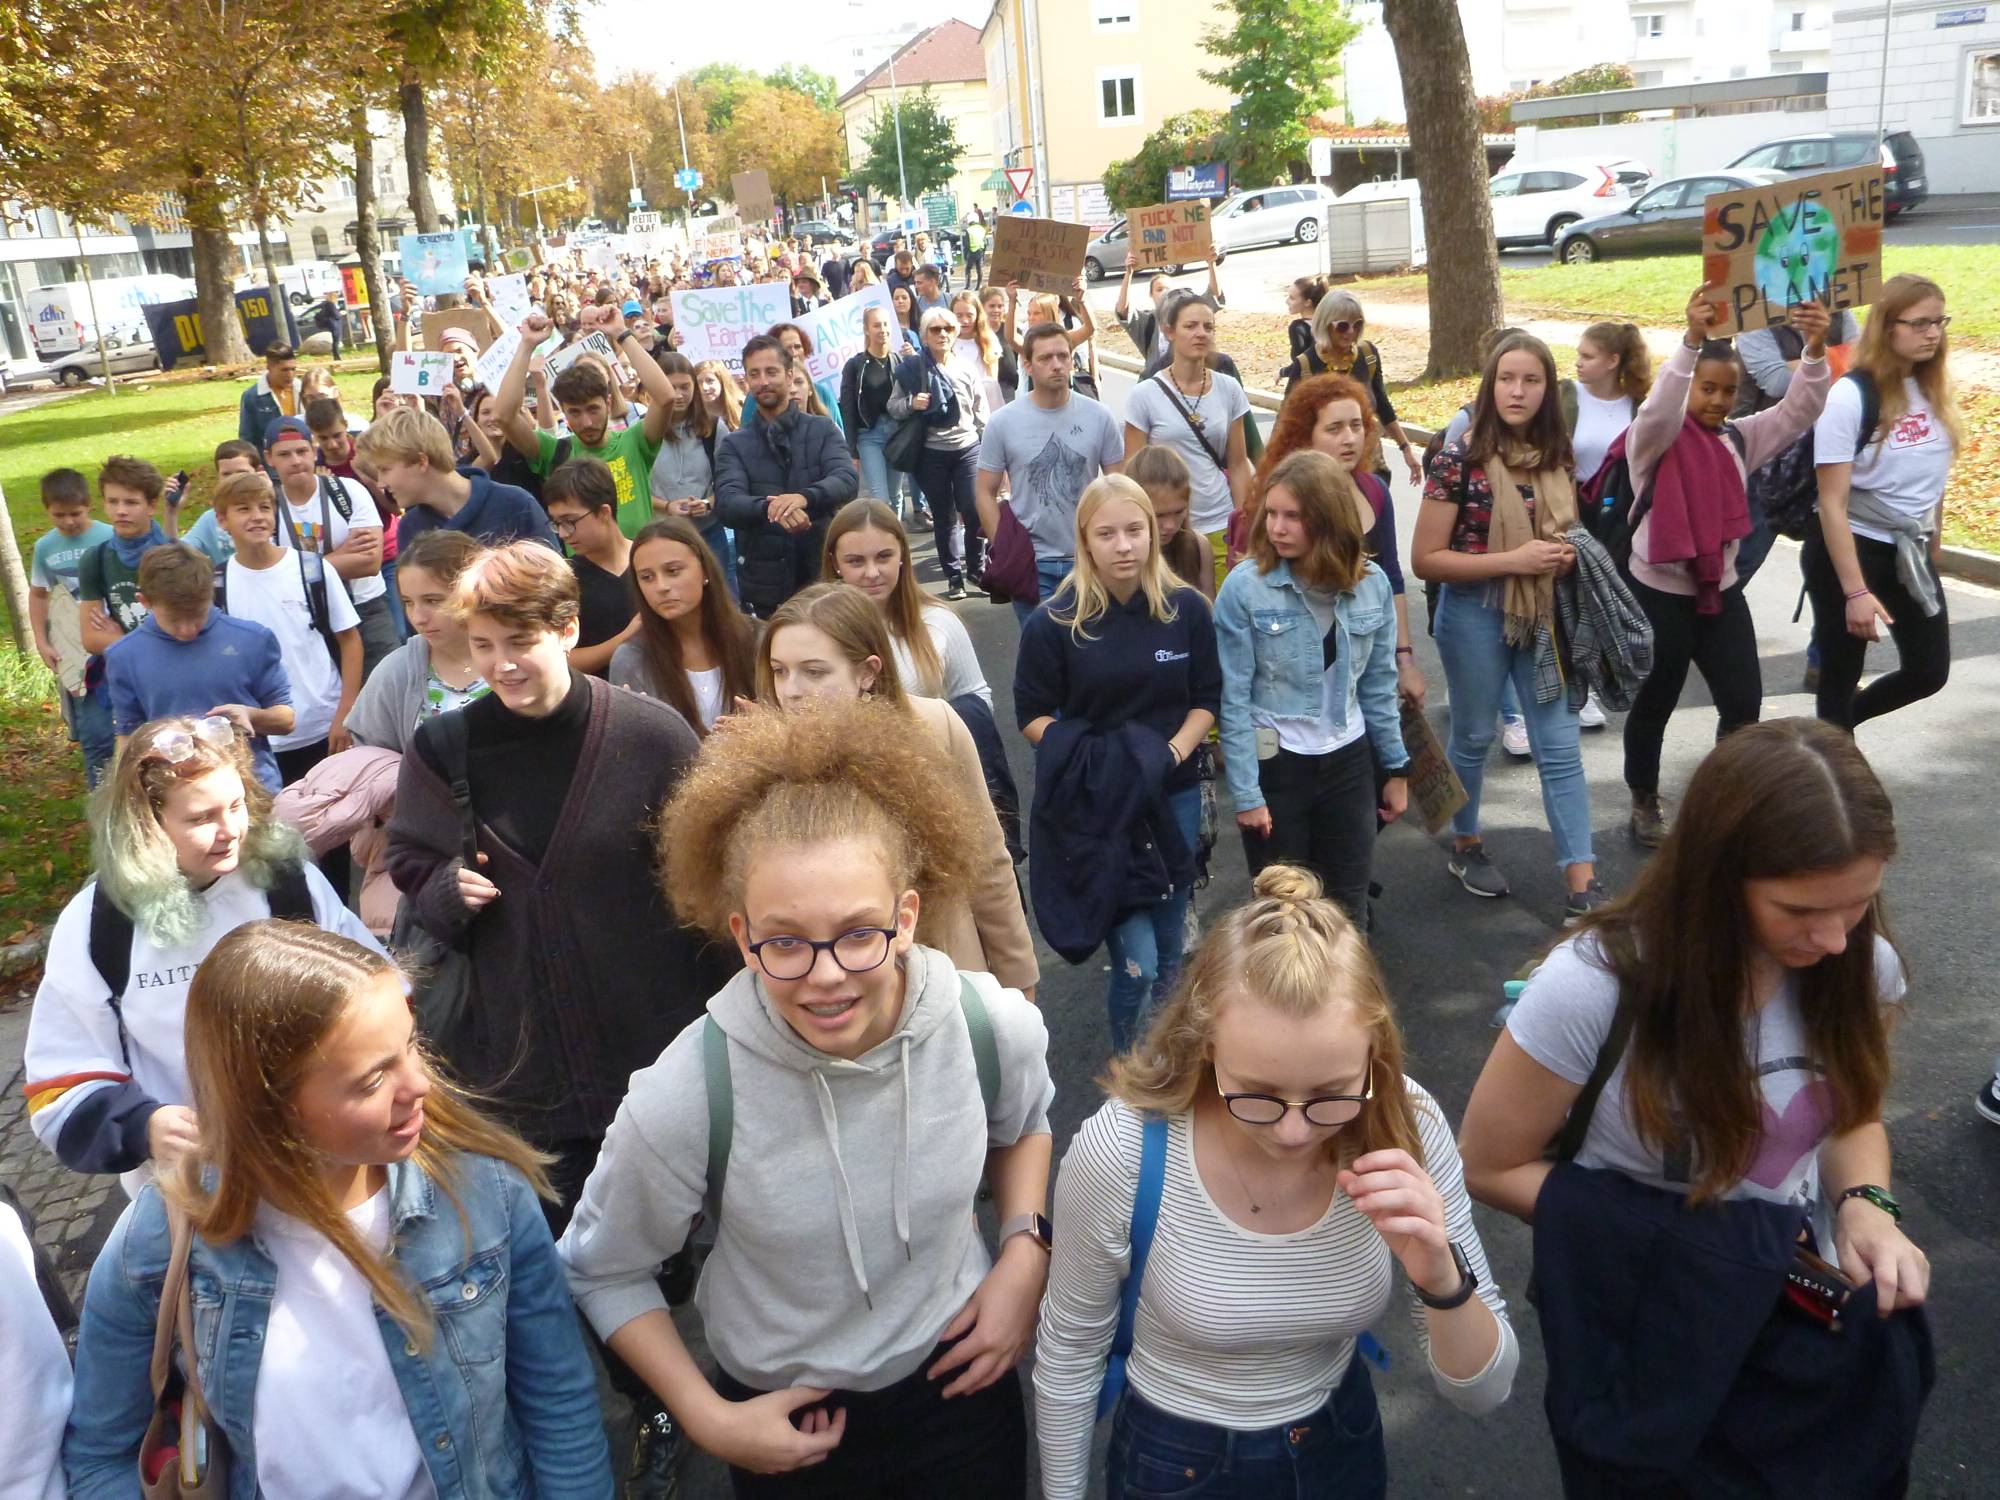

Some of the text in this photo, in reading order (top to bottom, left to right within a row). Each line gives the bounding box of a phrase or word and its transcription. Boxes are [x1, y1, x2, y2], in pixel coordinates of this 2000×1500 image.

[1140, 208, 1177, 228] FUCK
[1715, 178, 1882, 250] SAVE THE
[634, 223, 656, 233] OLAF
[1143, 224, 1196, 244] AND NOT
[706, 246, 733, 258] NEMO
[1029, 241, 1073, 263] PLASTIC
[1140, 245, 1168, 265] THE
[240, 297, 269, 318] 150
[1732, 263, 1869, 332] PLANET
[681, 293, 738, 327] Save
[417, 370, 430, 386] B
[136, 962, 201, 989] FAIT
